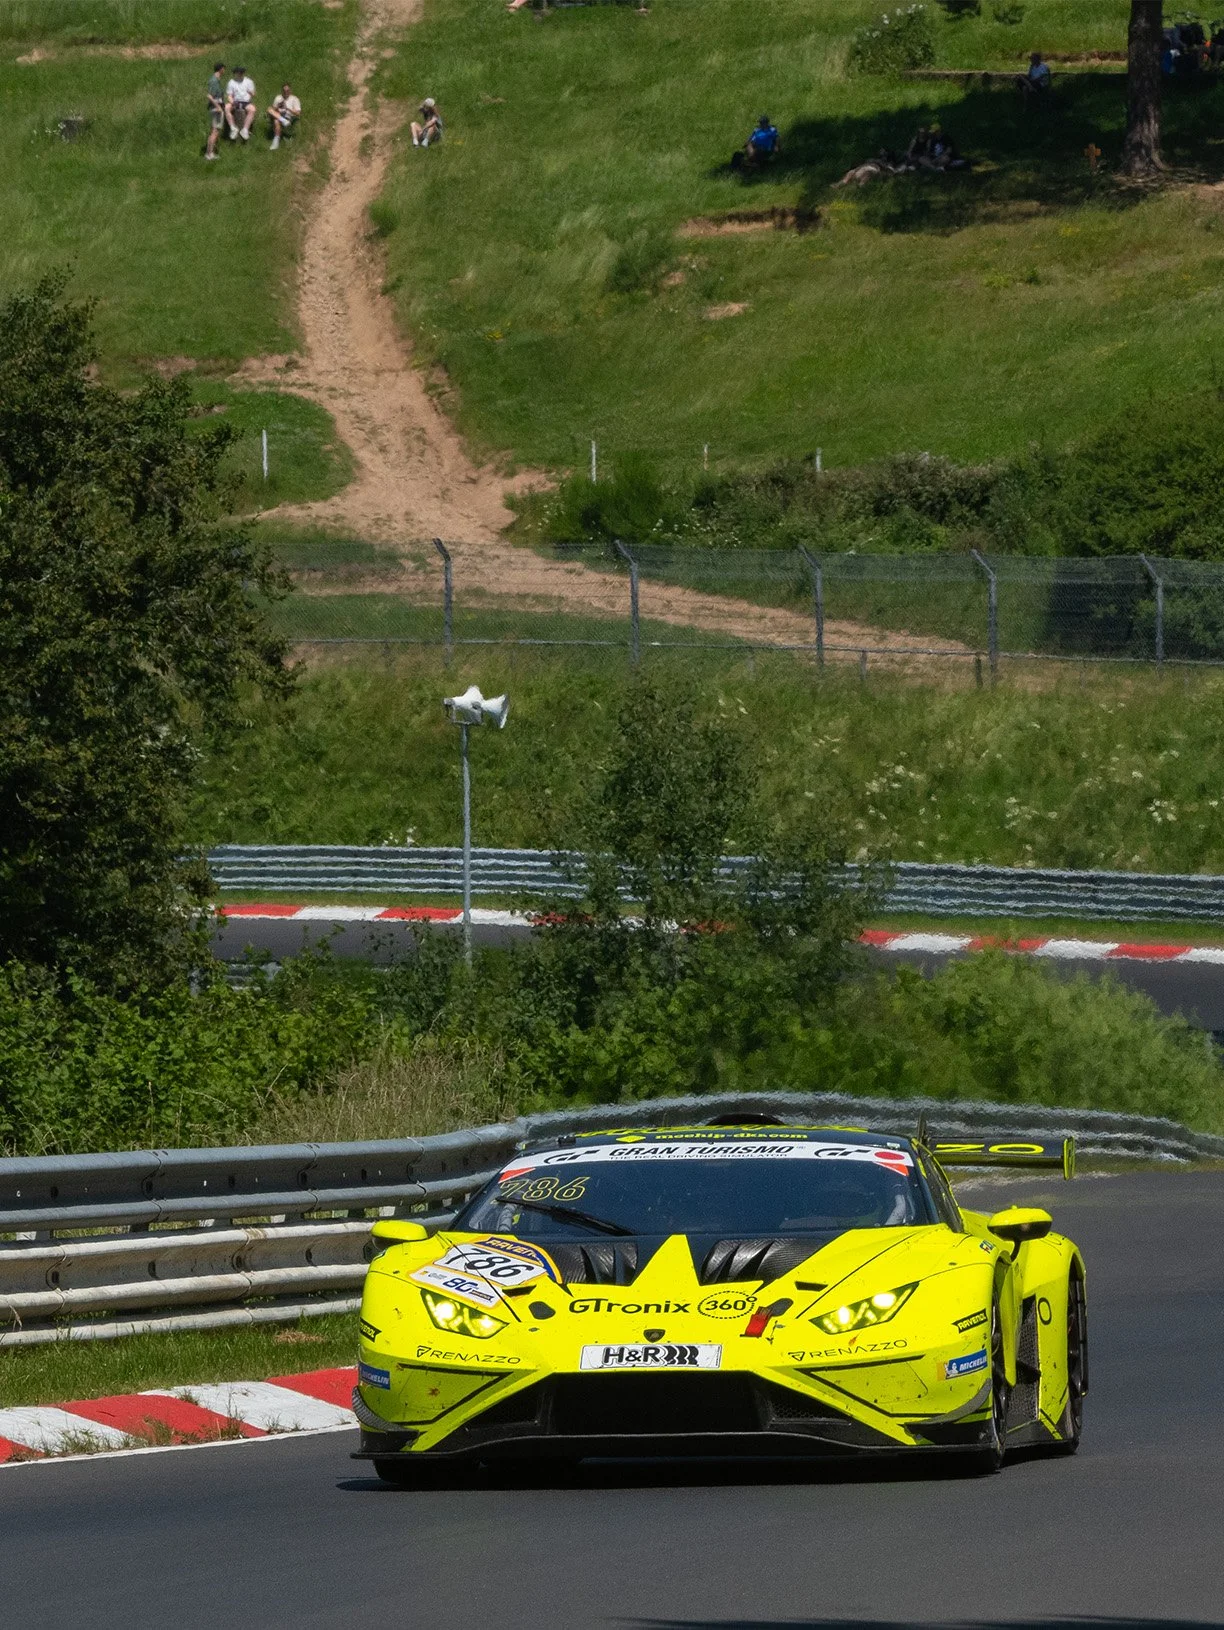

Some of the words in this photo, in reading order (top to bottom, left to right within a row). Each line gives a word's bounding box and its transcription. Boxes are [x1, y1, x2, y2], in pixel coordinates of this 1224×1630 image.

[608, 1146, 680, 1156] GRAN
[686, 1145, 795, 1155] TURISMO
[492, 1176, 591, 1203] 786
[445, 1248, 535, 1278] 786
[569, 1298, 691, 1314] GTronix
[430, 1350, 521, 1365] RENAZZO
[603, 1346, 661, 1364] H&R
[809, 1339, 908, 1358] RENAZZO
